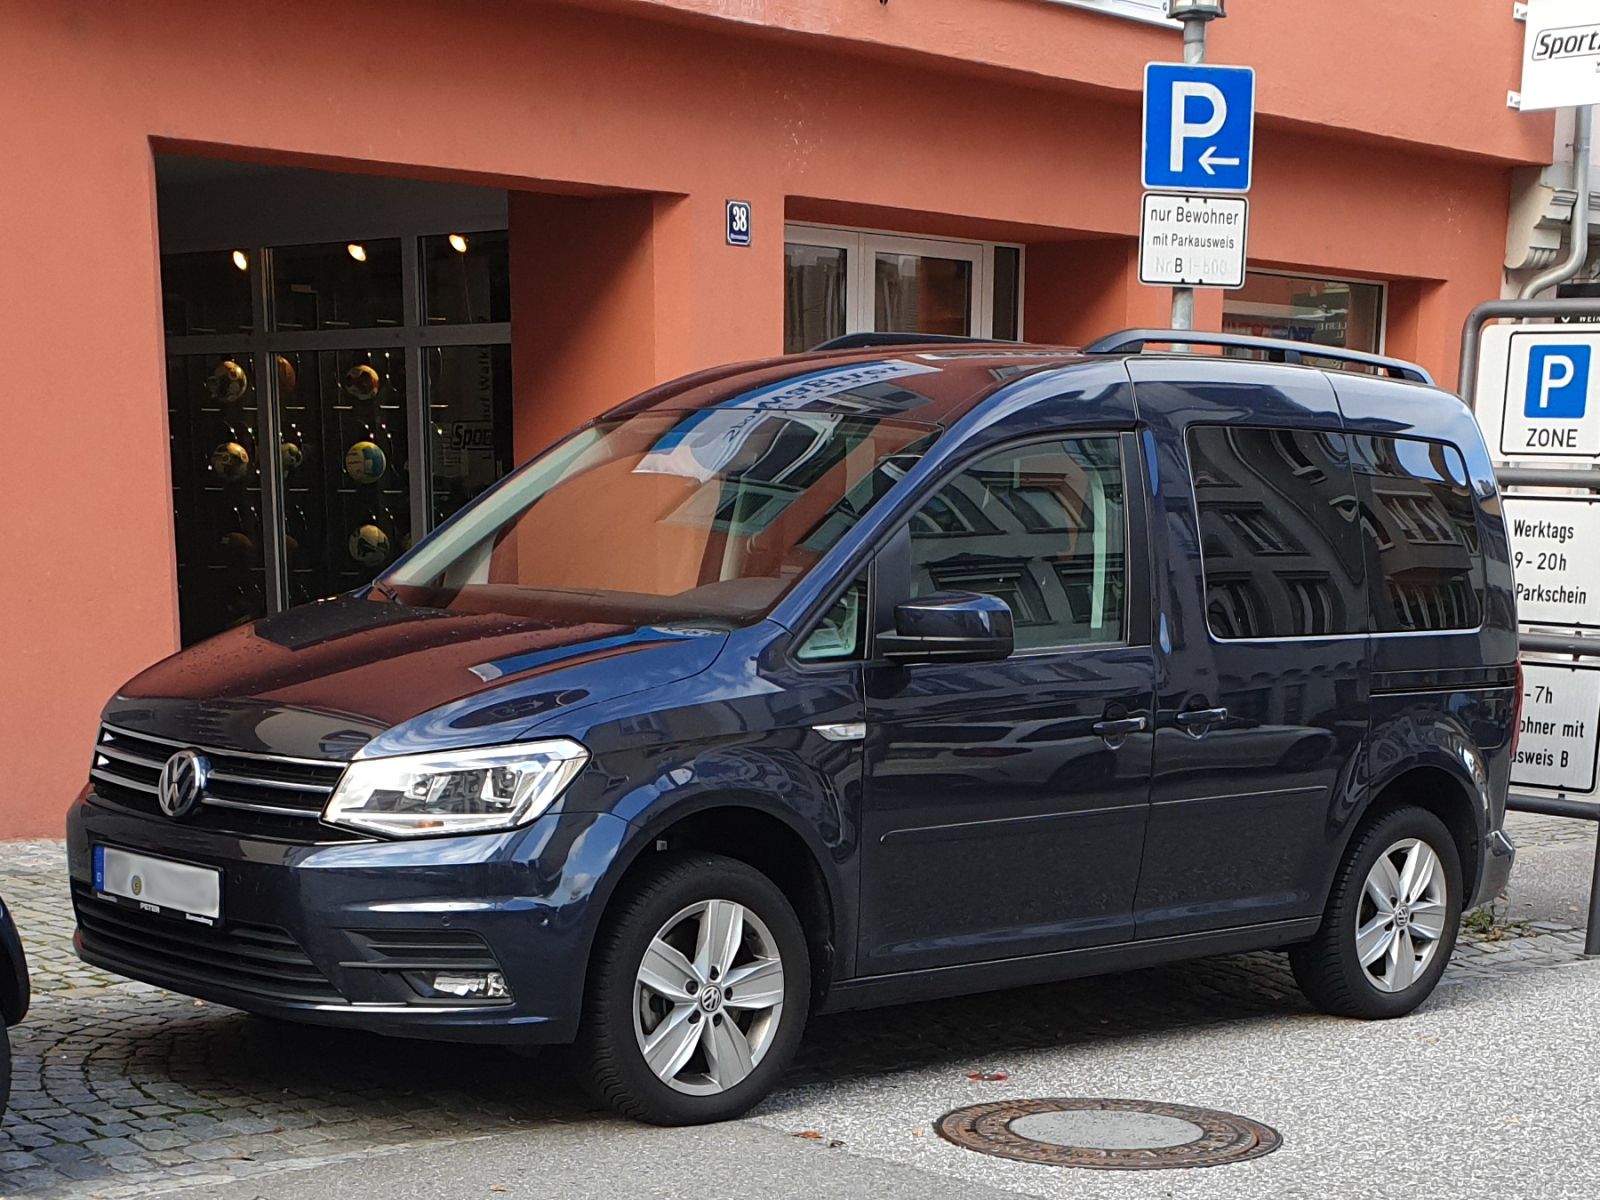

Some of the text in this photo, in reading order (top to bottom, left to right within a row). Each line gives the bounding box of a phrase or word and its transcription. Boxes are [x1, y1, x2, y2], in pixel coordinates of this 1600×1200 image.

[1536, 30, 1600, 60] Sport
[1169, 80, 1227, 173] P
[732, 205, 747, 232] 38
[1150, 206, 1239, 226] nur Bewohner
[1152, 233, 1235, 249] mit Parkausweis
[1174, 257, 1183, 274] B
[1539, 354, 1575, 409] P
[1525, 428, 1579, 448] ZONE
[1513, 519, 1575, 544] Werktags
[1516, 582, 1587, 605] Parkschein
[1520, 716, 1584, 738] ohner mit
[1560, 750, 1569, 768] B
